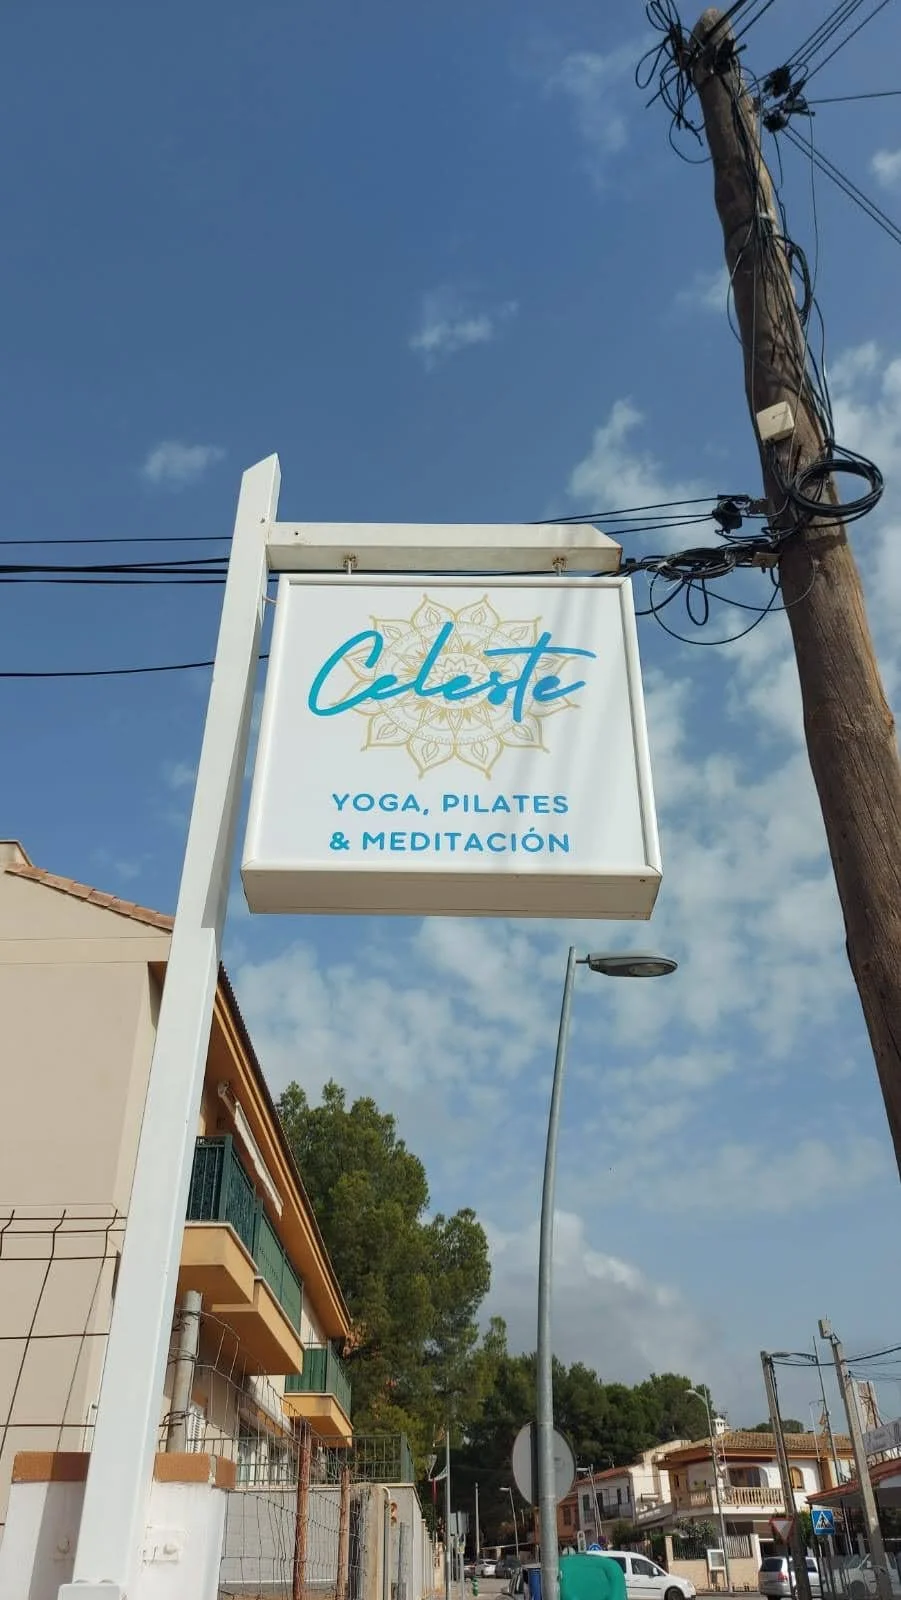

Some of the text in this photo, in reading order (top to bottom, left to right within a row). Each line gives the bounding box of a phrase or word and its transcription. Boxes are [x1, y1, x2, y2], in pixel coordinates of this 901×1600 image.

[307, 621, 597, 723] Celeste
[332, 793, 569, 816] YOGA, PILATES
[329, 827, 570, 853] & MEDITACIÓN
